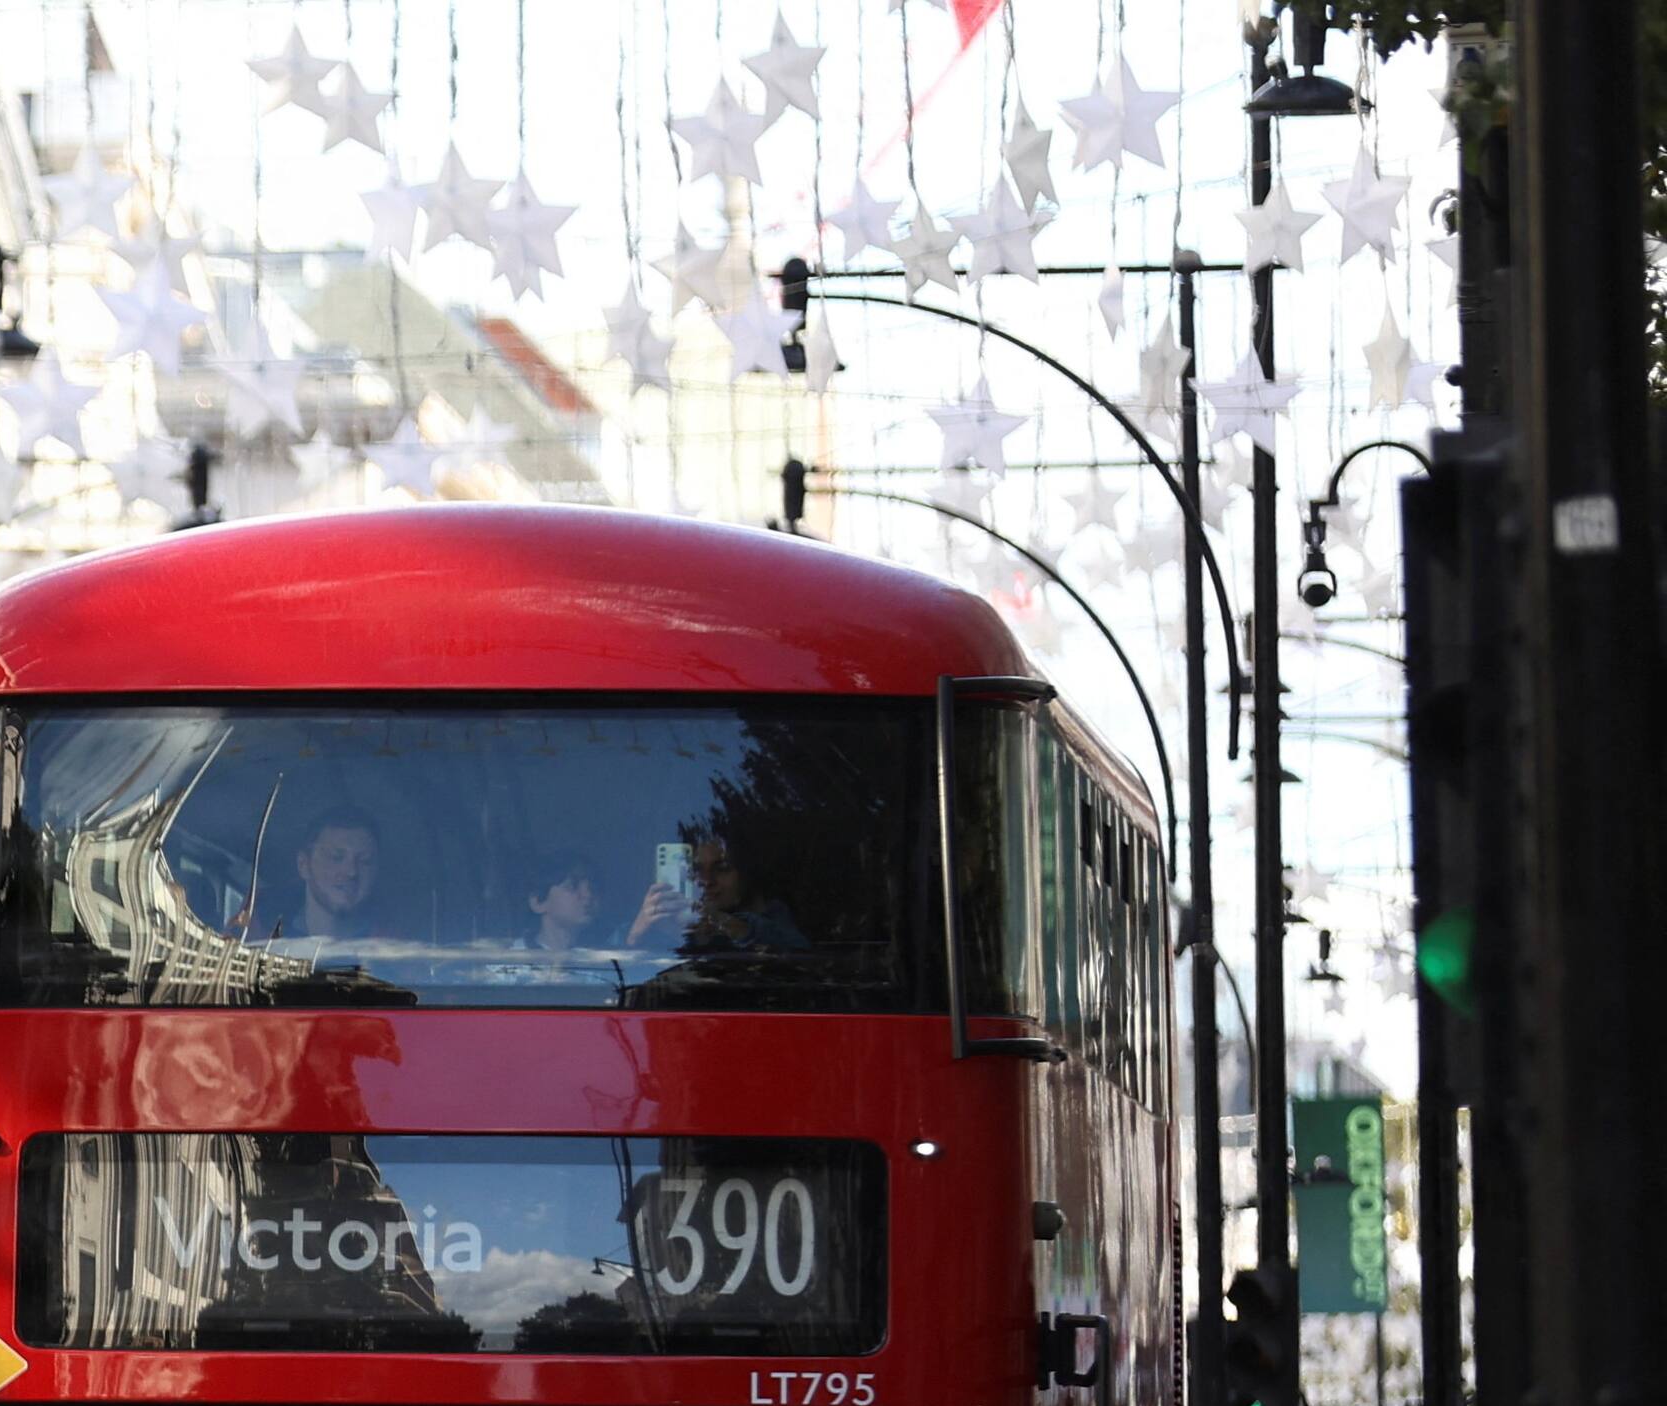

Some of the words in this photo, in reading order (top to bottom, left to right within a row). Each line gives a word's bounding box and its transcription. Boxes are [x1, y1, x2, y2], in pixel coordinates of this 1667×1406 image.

[154, 1196, 482, 1272] Victoria
[657, 1178, 815, 1296] 390
[1346, 1106, 1384, 1274] OXFORD
[750, 1371, 875, 1406] LT795
